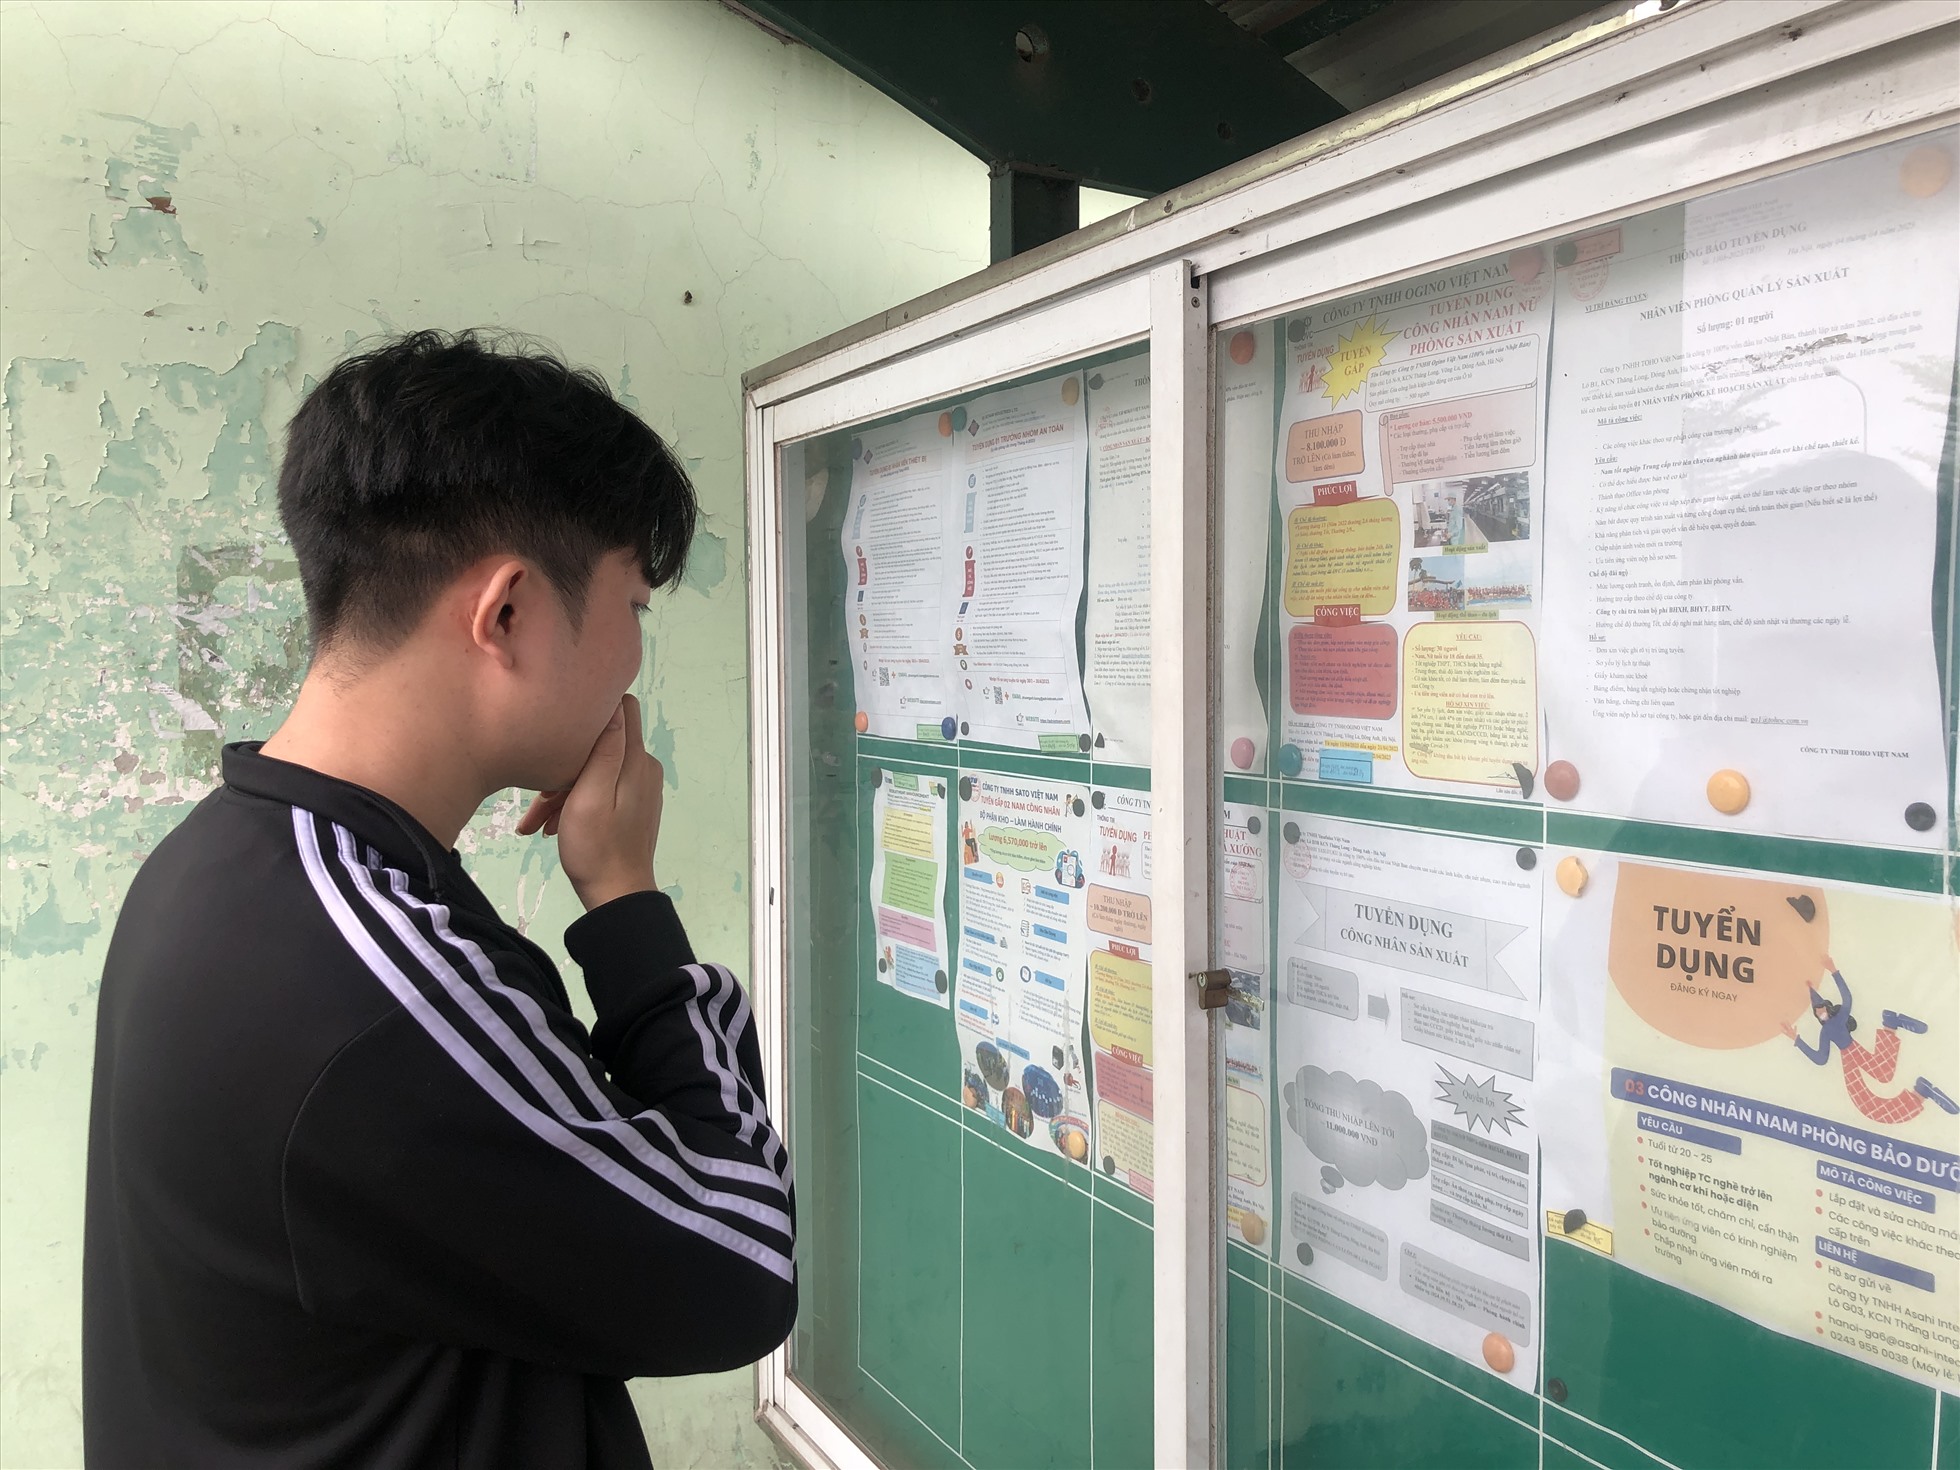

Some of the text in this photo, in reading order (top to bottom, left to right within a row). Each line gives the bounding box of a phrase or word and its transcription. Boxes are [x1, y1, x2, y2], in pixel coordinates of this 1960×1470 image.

[1323, 305, 1350, 323] CÔNG
[1352, 300, 1365, 313] TY
[1368, 291, 1402, 308] TNHH
[1405, 279, 1446, 300] OGINO
[1449, 270, 1479, 288] VIỆT
[1475, 286, 1513, 306] DỤNG
[1640, 306, 1666, 321] NHÂN
[1669, 300, 1691, 314] VIÊN
[1694, 292, 1729, 308] PHÒNG
[1732, 284, 1764, 301] QUẢN
[1767, 277, 1783, 292] LÝ
[1786, 274, 1811, 288] SẢN
[1403, 321, 1440, 340] CÔNG
[1442, 311, 1480, 332] NHÂN
[1483, 303, 1514, 322] NAM
[1696, 321, 1707, 333] Số
[1735, 316, 1745, 326] 01
[1409, 335, 1454, 356] PHÒNG
[1457, 328, 1483, 346] SẢN
[1305, 428, 1320, 439] THU
[1317, 485, 1338, 496] PHÚC
[1315, 606, 1359, 618] CÔNG VIỆC
[982, 781, 993, 791] CÔNG
[1000, 786, 1014, 795] TNHH
[1015, 788, 1030, 798] SATO
[1030, 789, 1044, 801] VIỆT
[1045, 792, 1059, 801] NAM
[1004, 800, 1011, 809] 02
[1011, 801, 1025, 811] NAM
[1026, 802, 1043, 813] CÔNG
[1043, 805, 1060, 816] NHÂN
[998, 815, 1009, 824] KHO
[1014, 817, 1027, 827] LÀM
[1027, 819, 1044, 829] HÀNH
[1044, 821, 1062, 833] CHÍNH
[1354, 903, 1453, 938] TUYỂN DỤNG
[1653, 905, 1761, 946] TUYỂN
[1340, 926, 1372, 945] CÔNG
[1374, 935, 1407, 953] NHÂN
[1409, 941, 1433, 959] SẢN
[1656, 942, 1754, 984] DỤNG
[1670, 982, 1738, 1002] ĐĂNG KÝ NGAY
[1325, 1106, 1341, 1119] THU
[1624, 1078, 1645, 1095] 03
[1647, 1084, 1697, 1109] CÔNG
[1700, 1096, 1751, 1123] NHÂN
[1755, 1110, 1798, 1136] NAM
[1801, 1123, 1866, 1155] PHÒNG
[1870, 1142, 1912, 1168] BẢO
[1640, 1115, 1683, 1135] YÊU CẦU
[1648, 1138, 1713, 1164] Tuổi từ 20 25
[1648, 1157, 1773, 1202] Tốt nghiệp TC nghề trở lên
[1648, 1172, 1759, 1213] ngành cơ khí hoặc điện
[1820, 1165, 1923, 1205] MÔ TẢ CÔNG VIỆC
[1829, 1192, 1936, 1234] Lắp đặt và sửa chữa
[1818, 1240, 1858, 1264] LIÊN HỆ
[1828, 1264, 1892, 1294] Hồ sơ gửi về
[1828, 1282, 1857, 1301] Công
[1858, 1294, 1870, 1306] ty
[1872, 1296, 1902, 1313] TNHH
[1904, 1308, 1935, 1325] Asahi
[1828, 1297, 1840, 1308] Lô
[1842, 1302, 1866, 1318] G03,
[1868, 1311, 1892, 1325] KCN
[1894, 1317, 1929, 1340] Thăng
[1830, 1330, 1856, 1347] 0243
[1858, 1341, 1879, 1355] 955
[1881, 1349, 1909, 1365] 0038
[1911, 1357, 1940, 1377] (Máy
